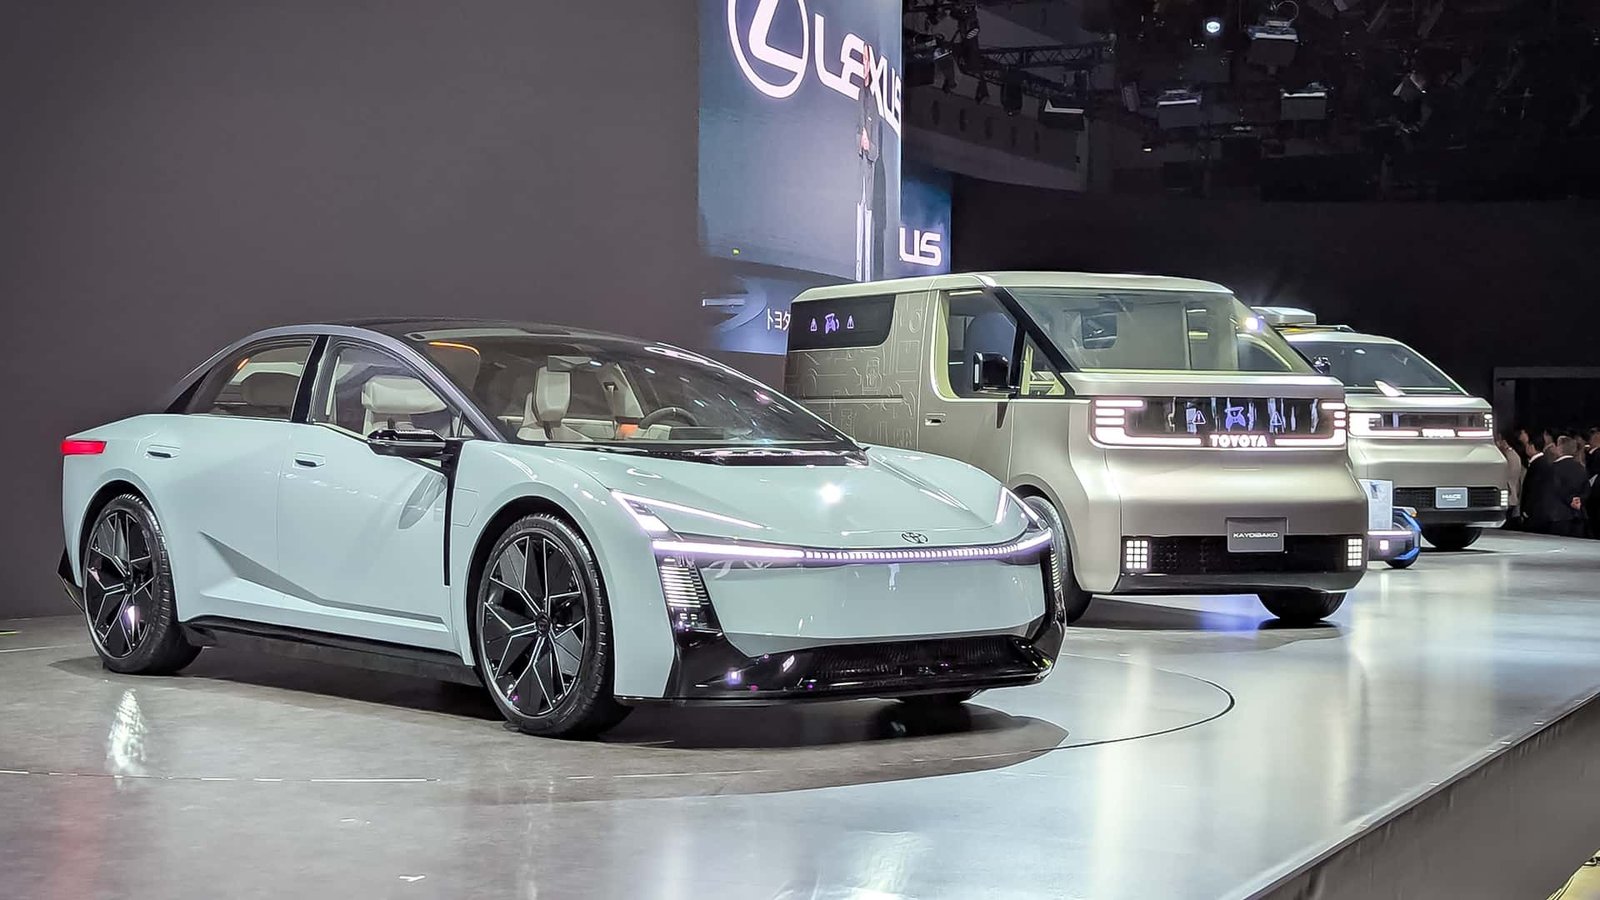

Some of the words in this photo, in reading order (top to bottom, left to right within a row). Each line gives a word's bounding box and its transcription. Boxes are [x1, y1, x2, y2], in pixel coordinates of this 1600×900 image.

[815, 13, 902, 137] LEXUS
[767, 308, 791, 331] トヨタ
[1209, 433, 1268, 448] TOYOTA
